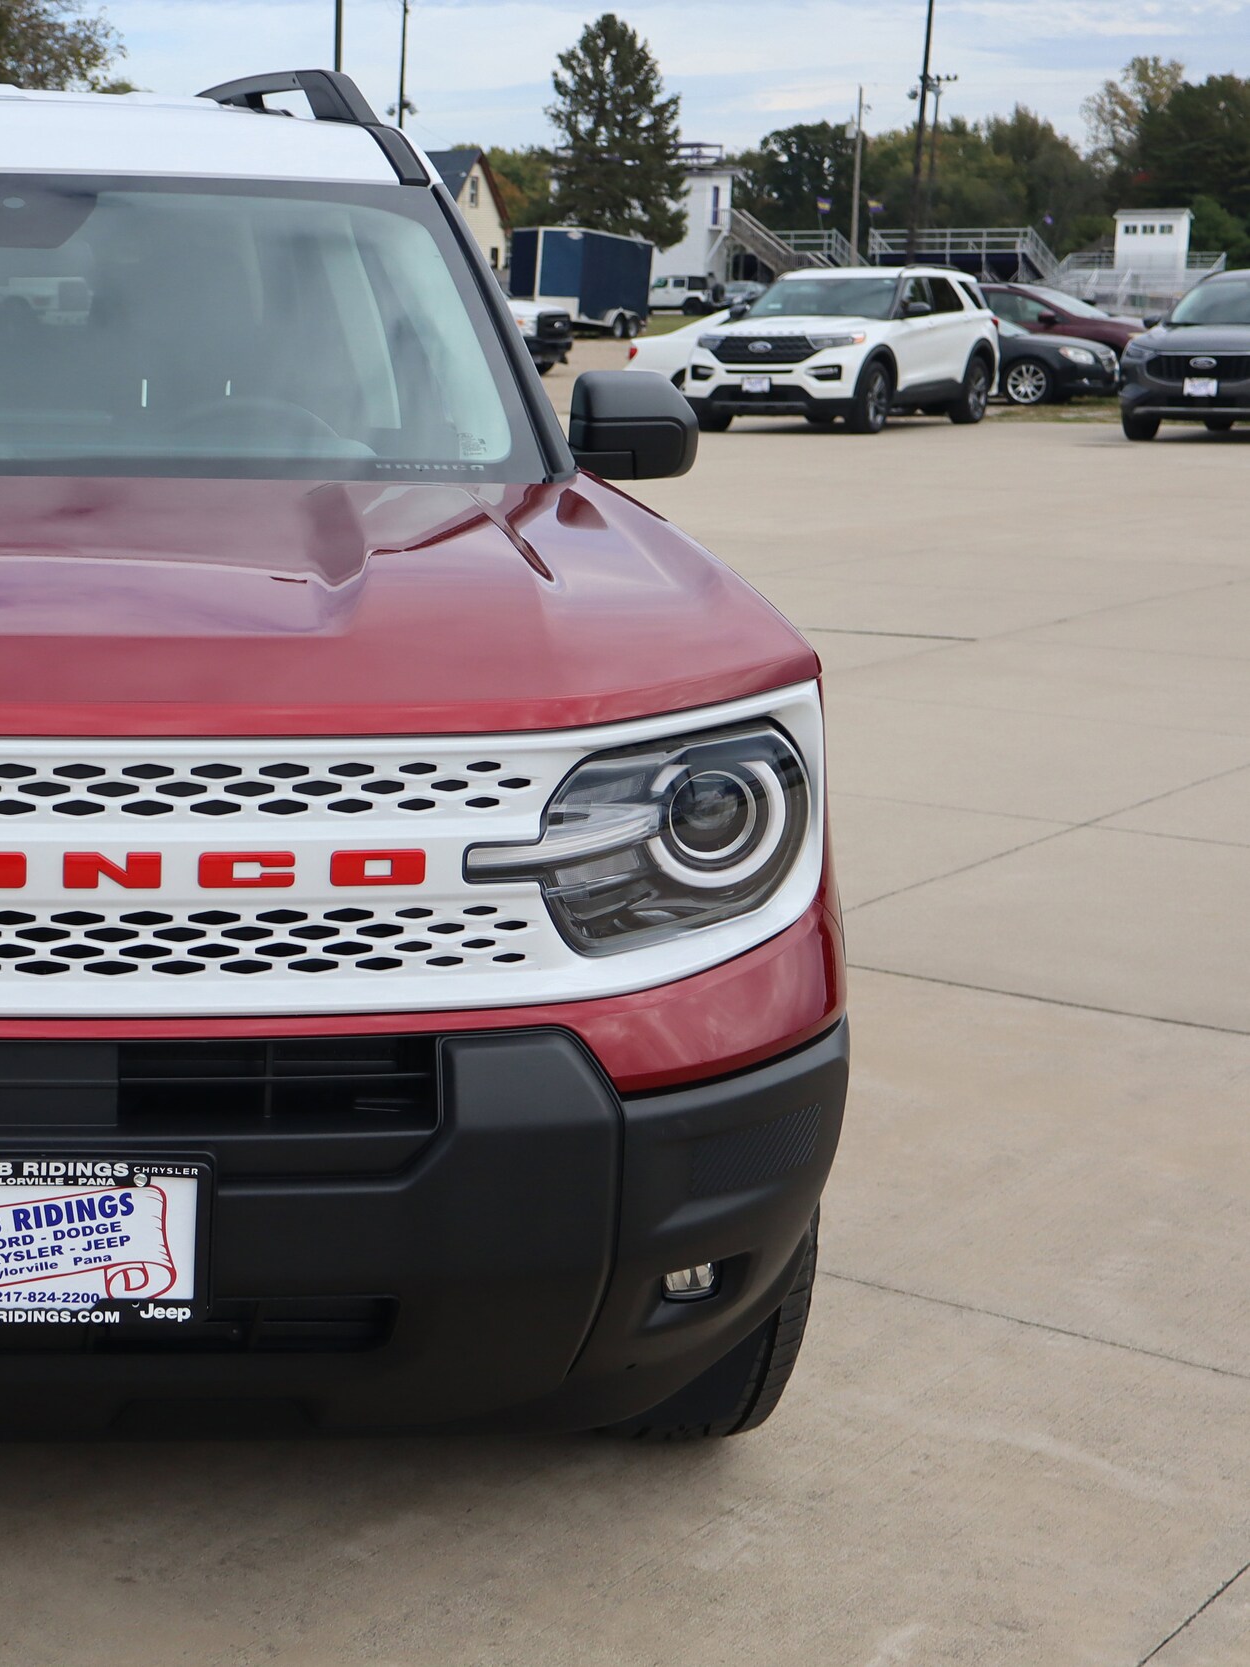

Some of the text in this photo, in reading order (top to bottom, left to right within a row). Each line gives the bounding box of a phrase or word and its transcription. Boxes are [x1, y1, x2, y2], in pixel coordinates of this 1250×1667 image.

[22, 1162, 129, 1177] RIDINGS
[133, 1166, 199, 1175] CHRYSLER
[78, 1178, 116, 1186] PANA
[12, 1192, 135, 1232] RIDINGS
[52, 1221, 122, 1241] DODGE
[82, 1235, 131, 1252] JEEP
[73, 1253, 112, 1267] Pana
[140, 1303, 191, 1322] Jeep
